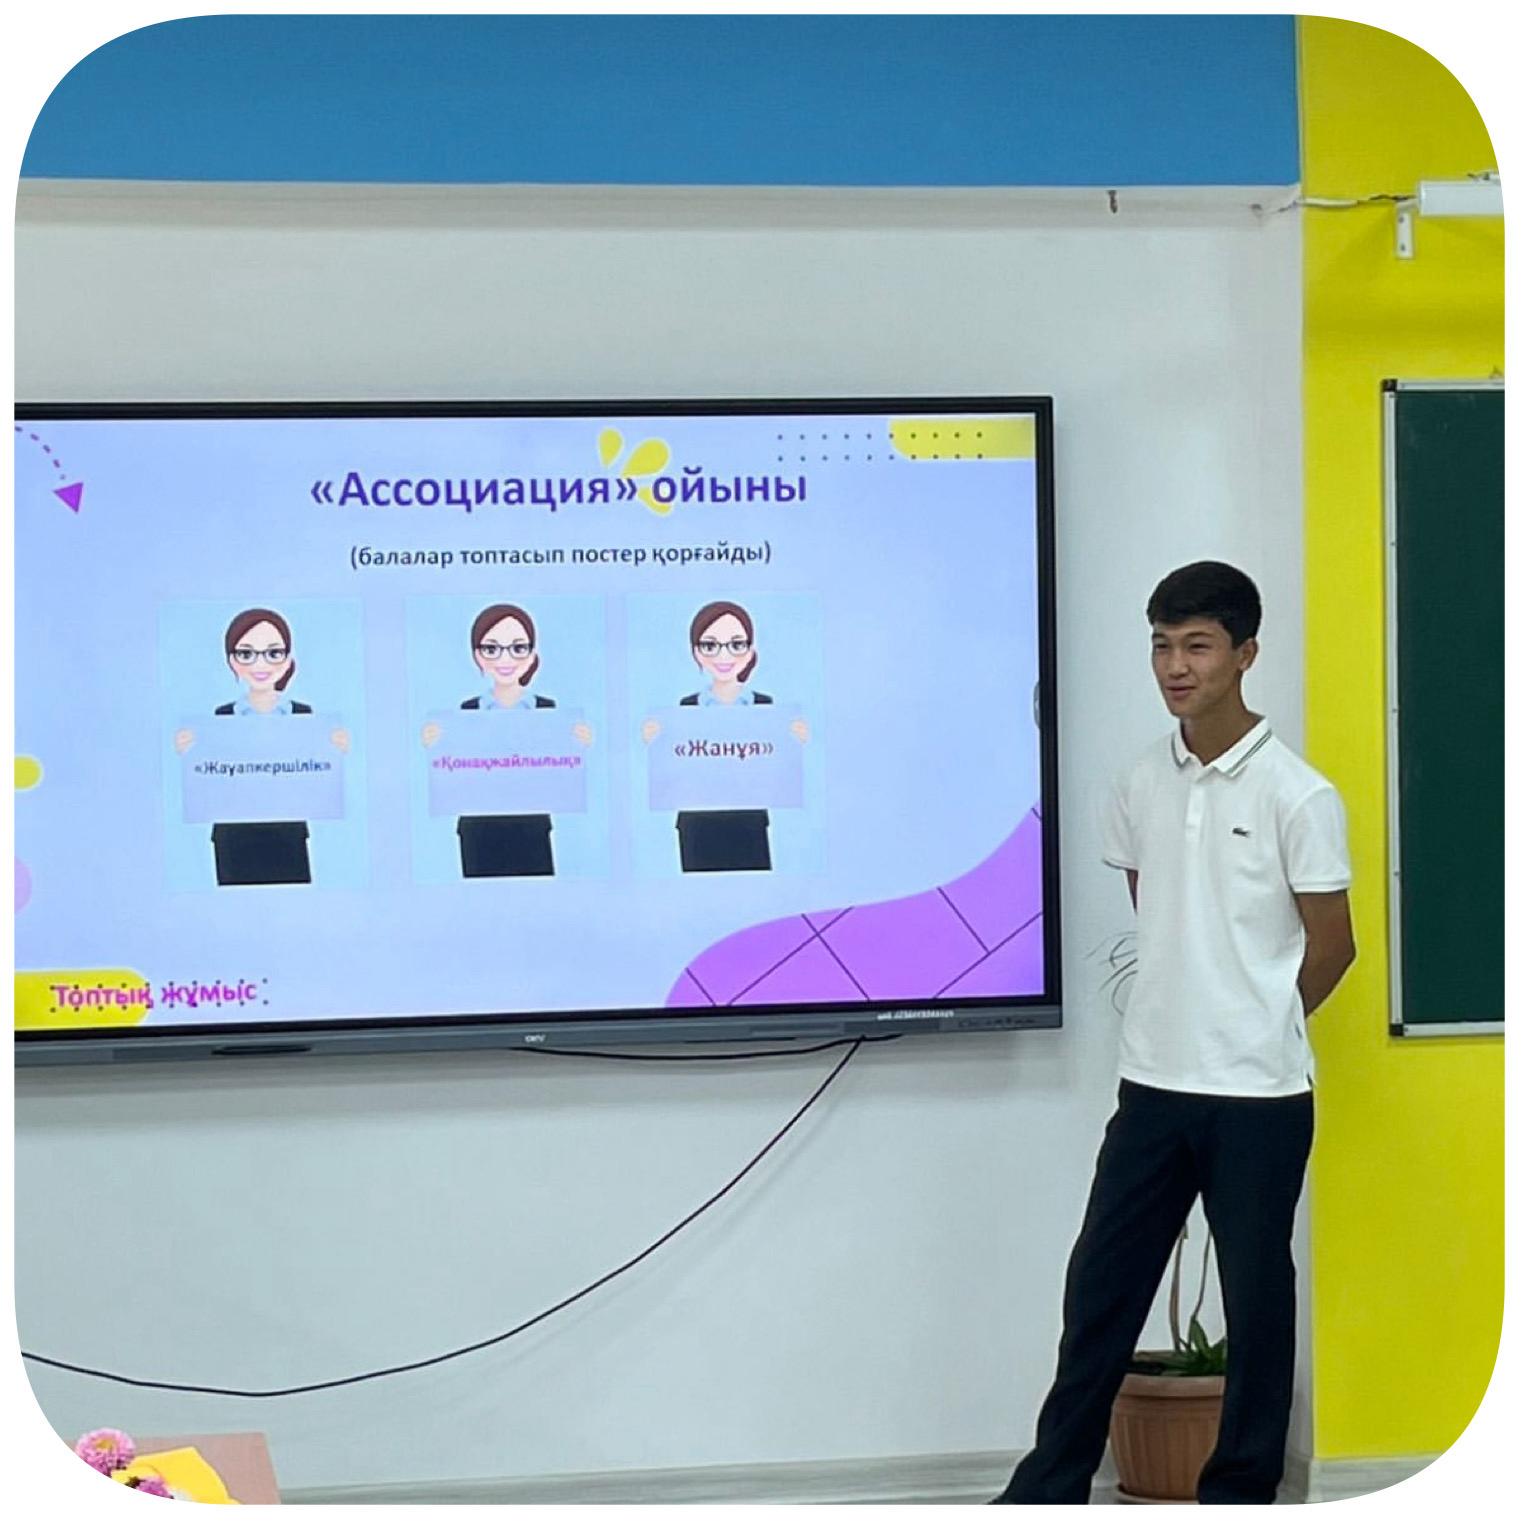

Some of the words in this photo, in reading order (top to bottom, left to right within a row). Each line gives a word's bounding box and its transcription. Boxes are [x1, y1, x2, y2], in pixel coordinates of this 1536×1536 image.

[310, 471, 638, 512] «Ассоциация»
[651, 467, 808, 504] ойыны
[351, 545, 454, 570] (балалар
[459, 547, 565, 569] топтасып
[571, 546, 647, 568] постер
[652, 540, 772, 566] қорғайды)
[674, 740, 774, 761] «Жанұя»
[54, 984, 154, 1008] Топтық
[161, 983, 257, 1008] жұмыс
